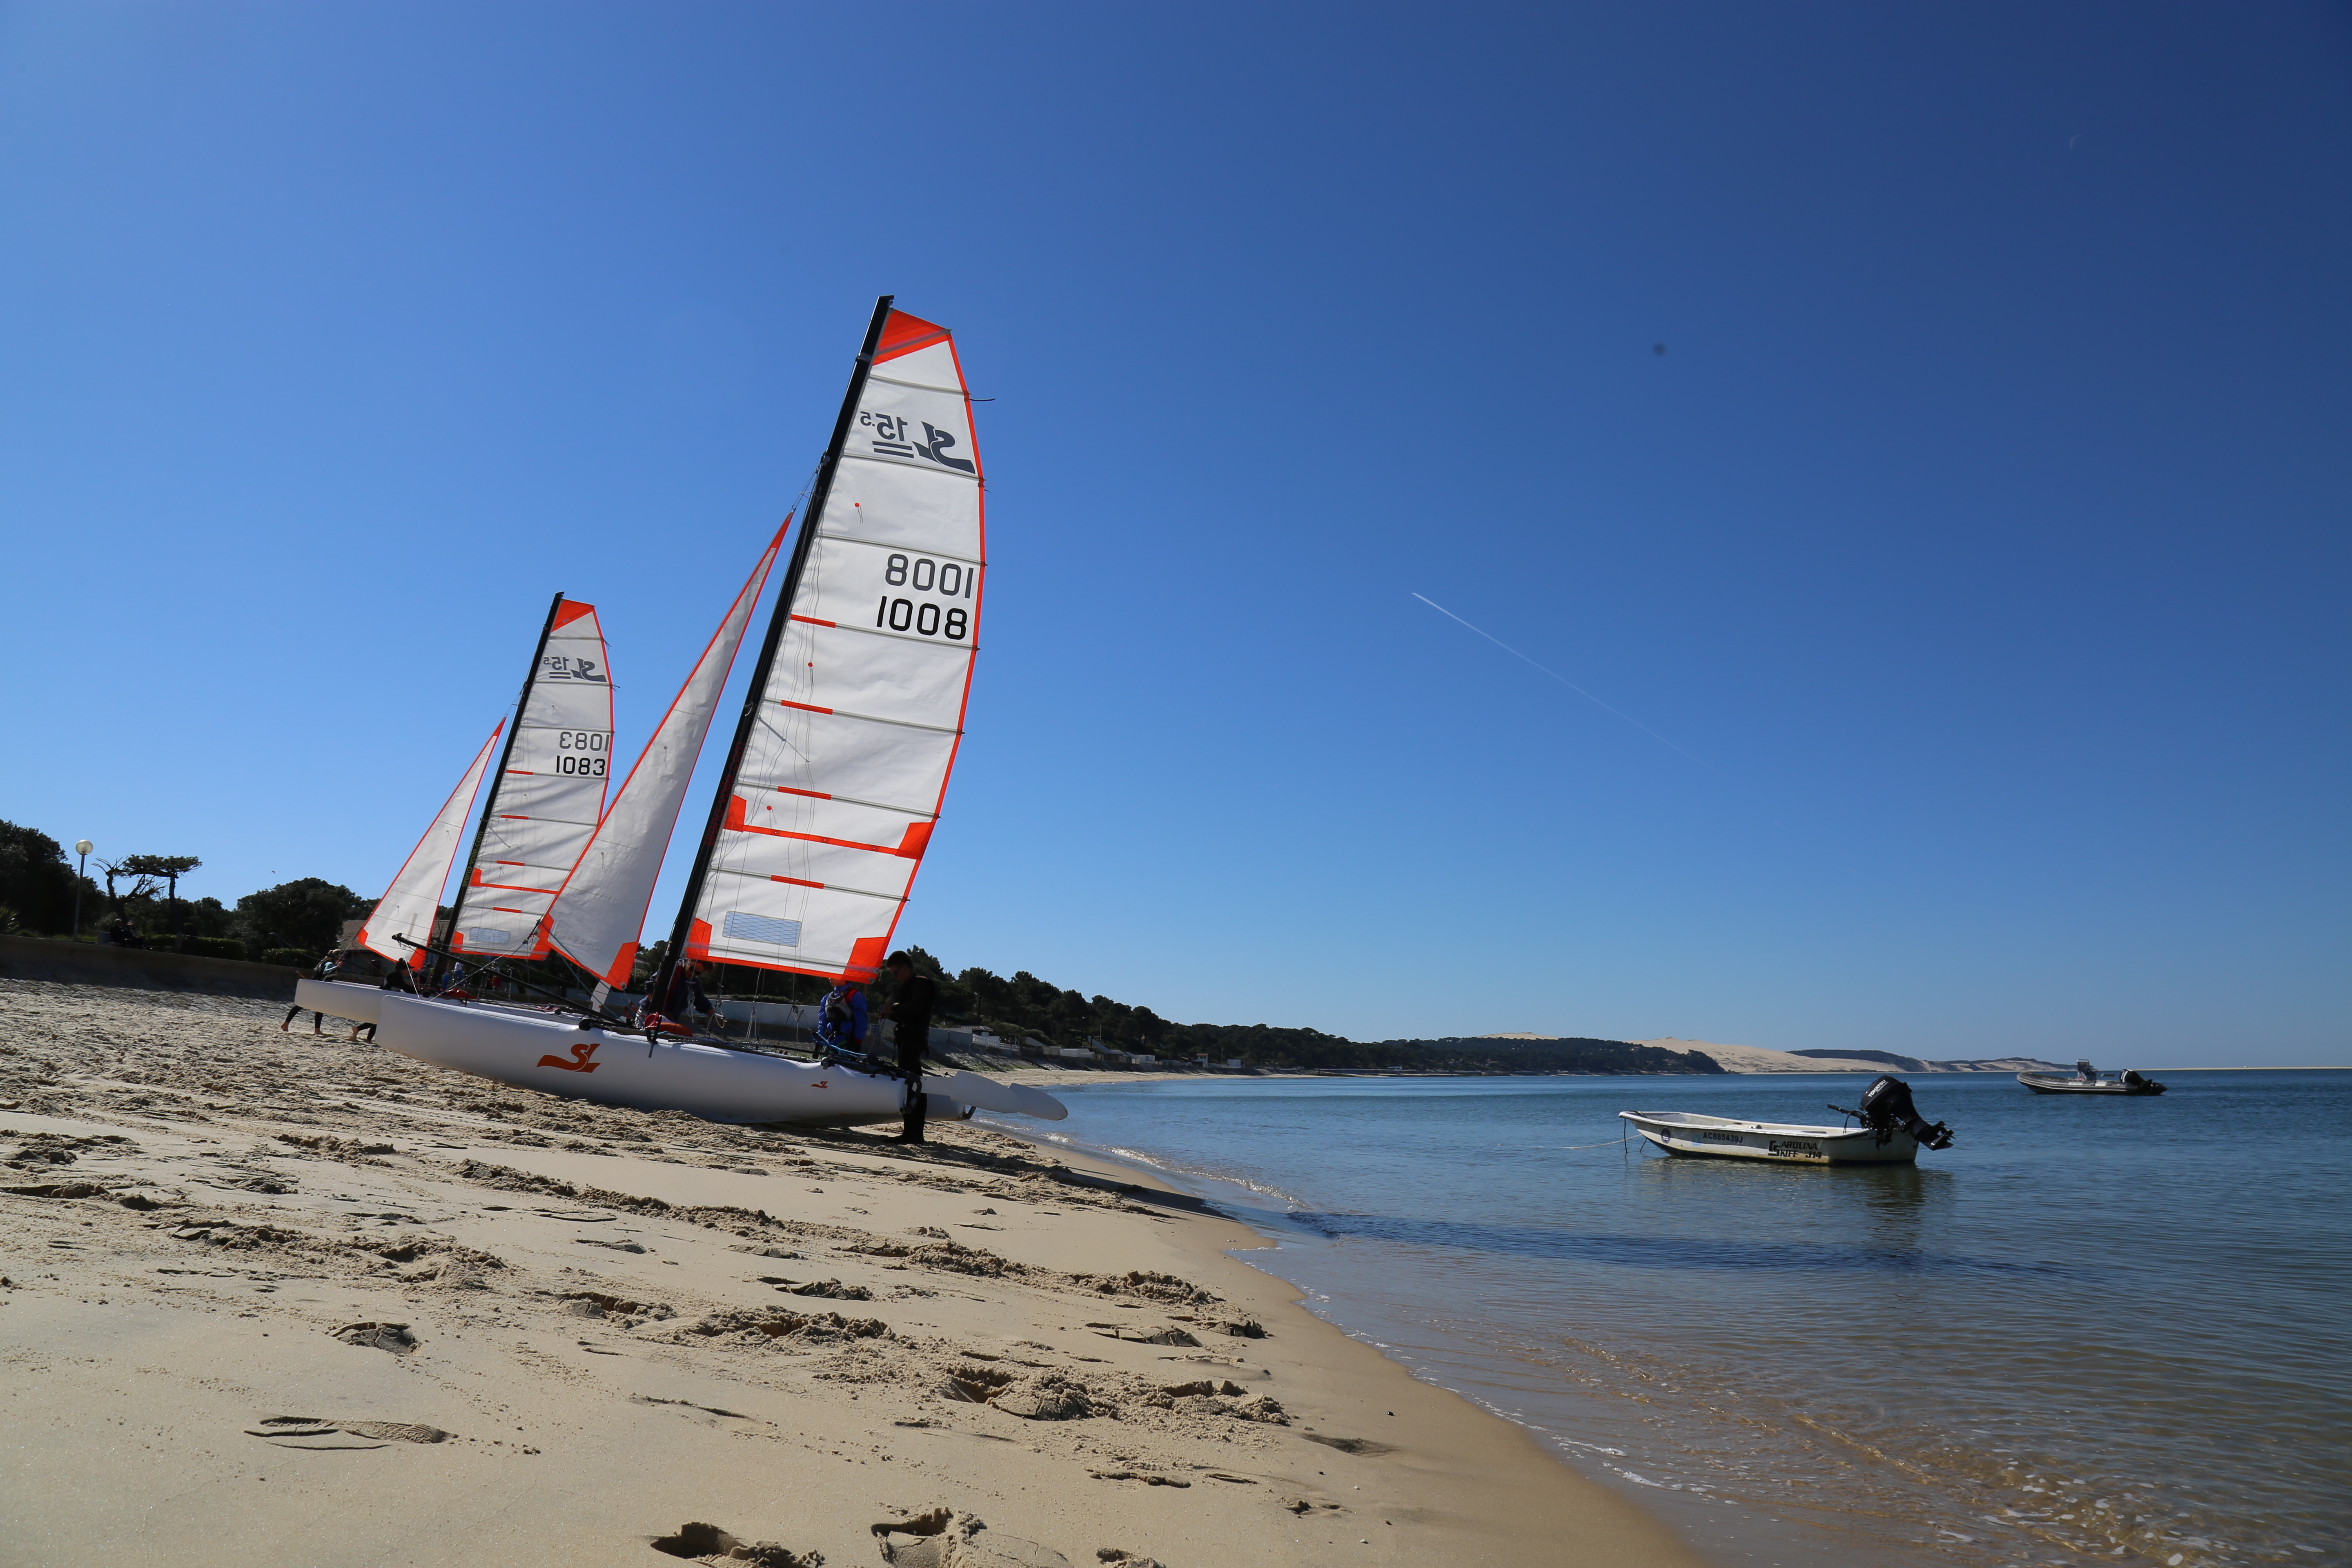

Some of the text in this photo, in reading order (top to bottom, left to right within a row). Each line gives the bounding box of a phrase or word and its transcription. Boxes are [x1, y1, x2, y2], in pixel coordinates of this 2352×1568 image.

[877, 596, 967, 640] 1008
[556, 755, 605, 776] 1083
[705, 742, 745, 847] sirena-voile.com
[462, 831, 483, 887] sirena-voile.com
[537, 1043, 601, 1073] SL
[1868, 1079, 1886, 1097] TOHATSU
[1703, 1132, 1743, 1143] AC885439J
[1805, 1151, 1822, 1159] J14
